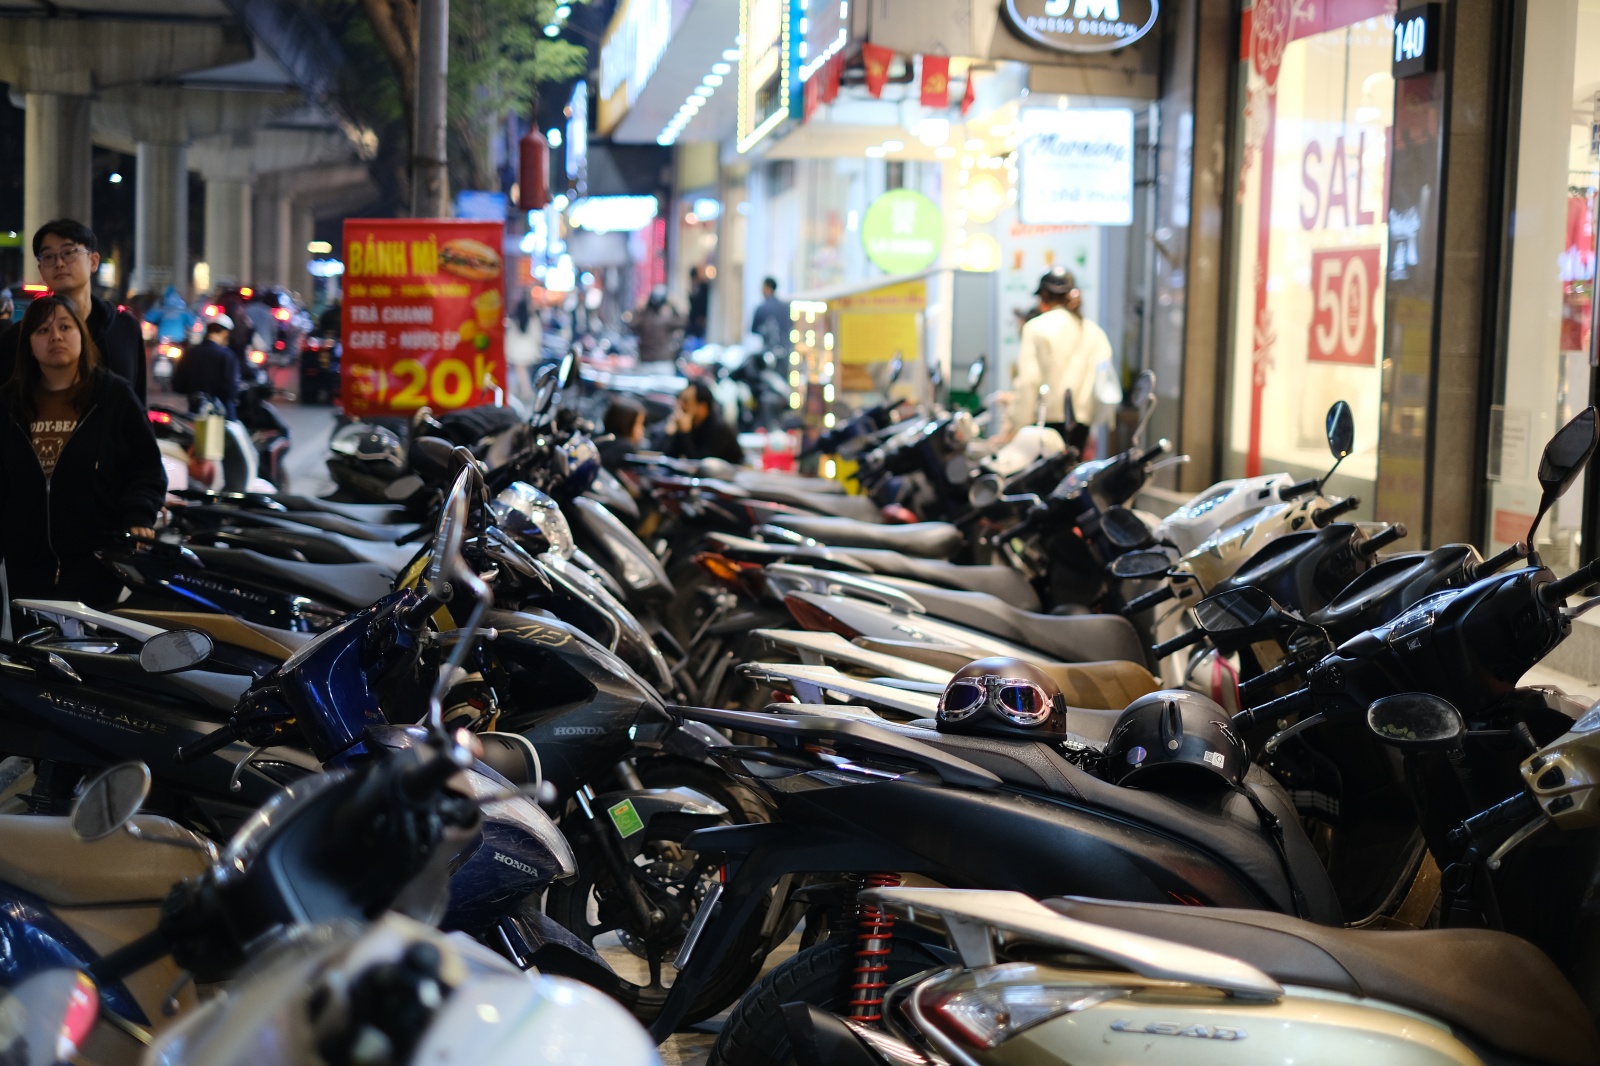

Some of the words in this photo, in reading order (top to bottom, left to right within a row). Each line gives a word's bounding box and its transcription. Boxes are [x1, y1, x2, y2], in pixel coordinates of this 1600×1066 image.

[1078, 19, 1138, 37] DESIGN
[1395, 16, 1426, 62] 140
[348, 233, 407, 277] BÁNH
[411, 233, 439, 277] MÌ
[351, 303, 378, 324] TRÀ
[381, 306, 433, 324] CHANH
[1316, 256, 1369, 357] 50
[350, 331, 387, 350] CAFE
[68, 710, 93, 721] BLACK
[96, 718, 126, 730] EDITION
[554, 726, 607, 736] HONDA
[494, 851, 539, 878] HONDA
[1110, 1018, 1248, 1041] LEAD
